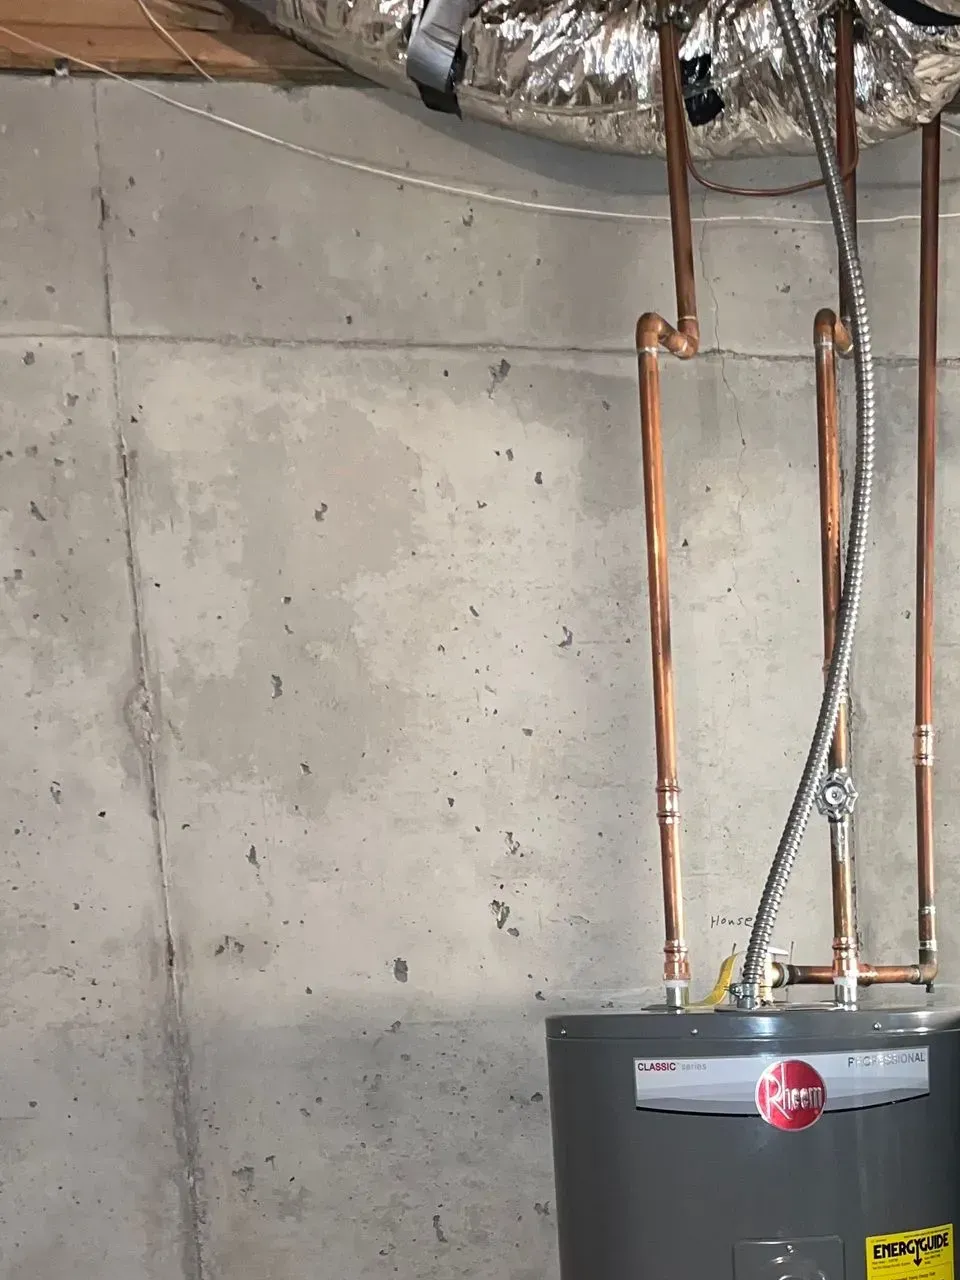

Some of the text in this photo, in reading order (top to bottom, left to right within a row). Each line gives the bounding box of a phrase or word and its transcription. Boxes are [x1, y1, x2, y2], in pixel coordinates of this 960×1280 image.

[637, 1062, 707, 1072] CLASSIC series
[848, 1052, 925, 1068] PROFESSIONAL
[764, 1062, 822, 1120] Rheem
[873, 1232, 949, 1260] ENERGYGUIDE
